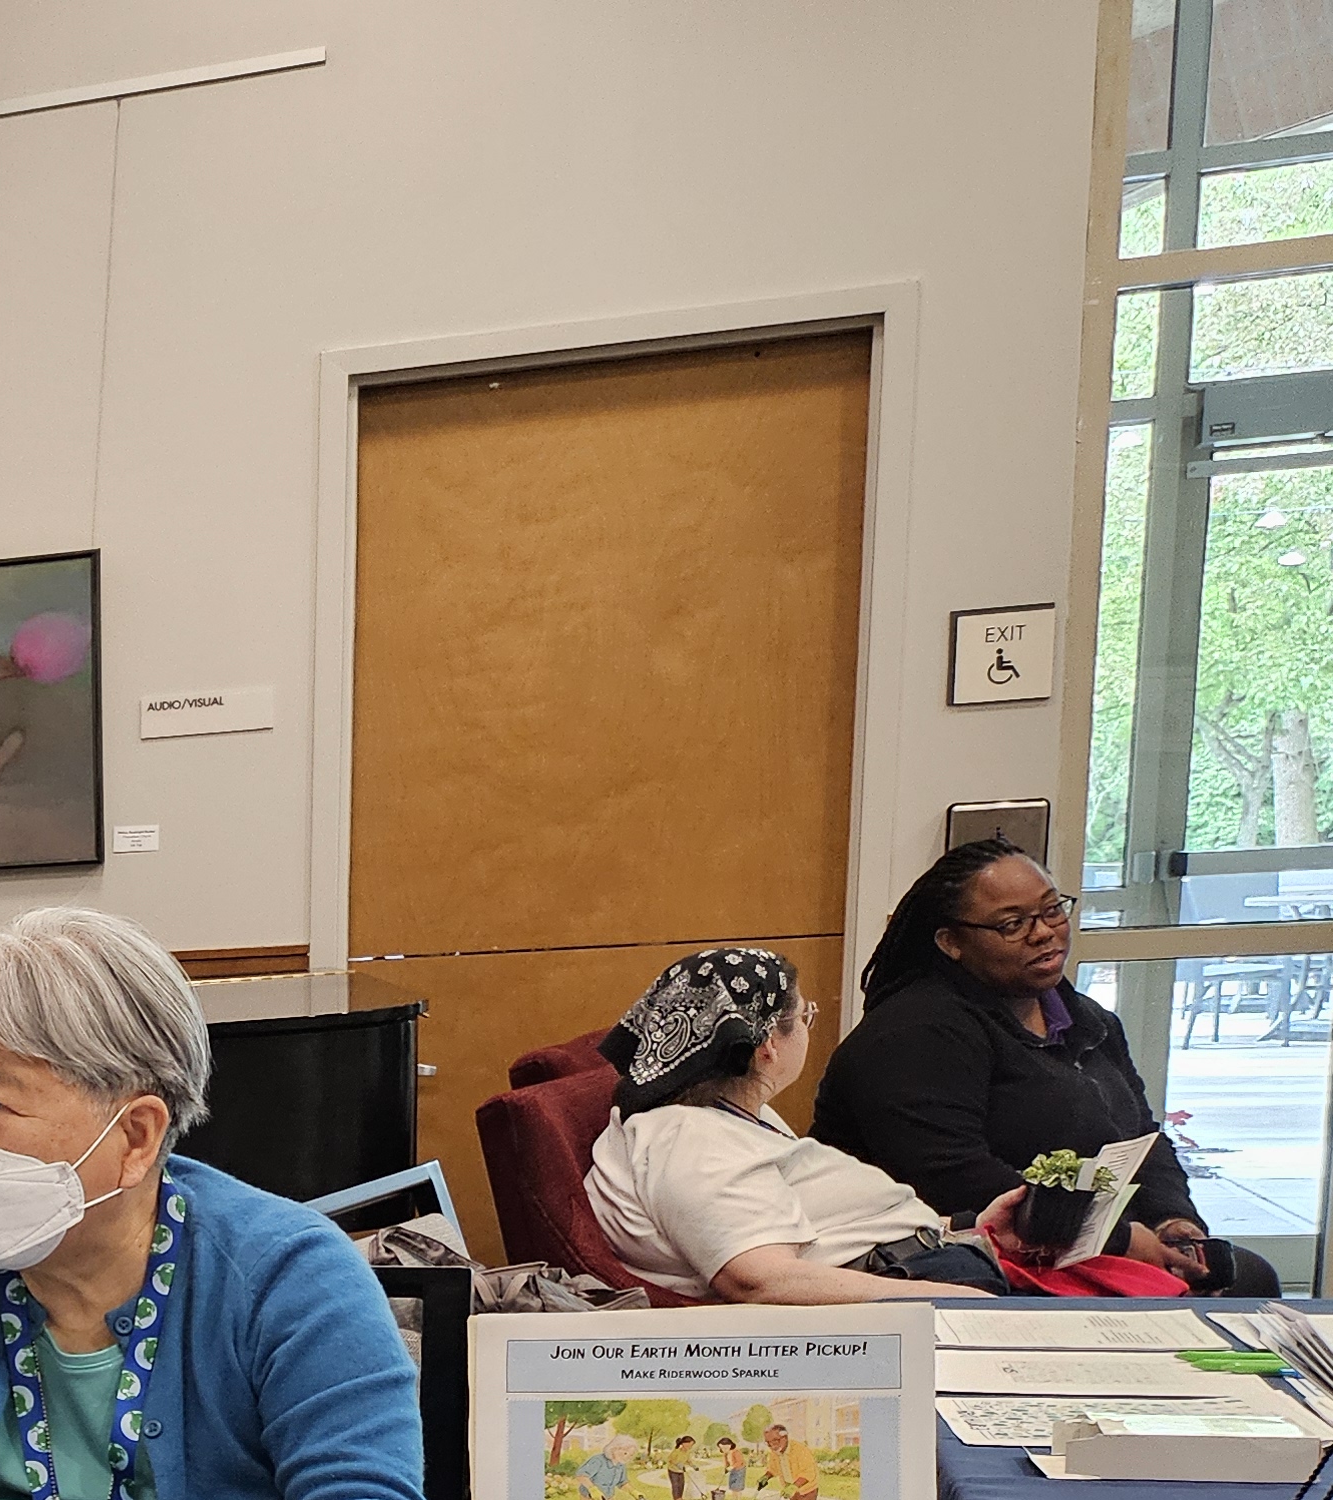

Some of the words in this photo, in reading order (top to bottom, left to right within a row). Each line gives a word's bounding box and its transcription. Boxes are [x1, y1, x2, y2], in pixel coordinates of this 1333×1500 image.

[985, 624, 1027, 643] EXIT
[146, 696, 224, 712] AUDIO/VISUAL
[550, 1345, 585, 1360] JOIN
[592, 1345, 624, 1359] OUR
[630, 1344, 678, 1359] EARTH
[684, 1343, 742, 1358] MONTH
[748, 1342, 799, 1357] LITTER
[805, 1341, 868, 1356] PICKUP!
[621, 1369, 655, 1379] MAKE
[658, 1368, 729, 1379] RIDERWOOD
[731, 1367, 779, 1378] SPARKLE
